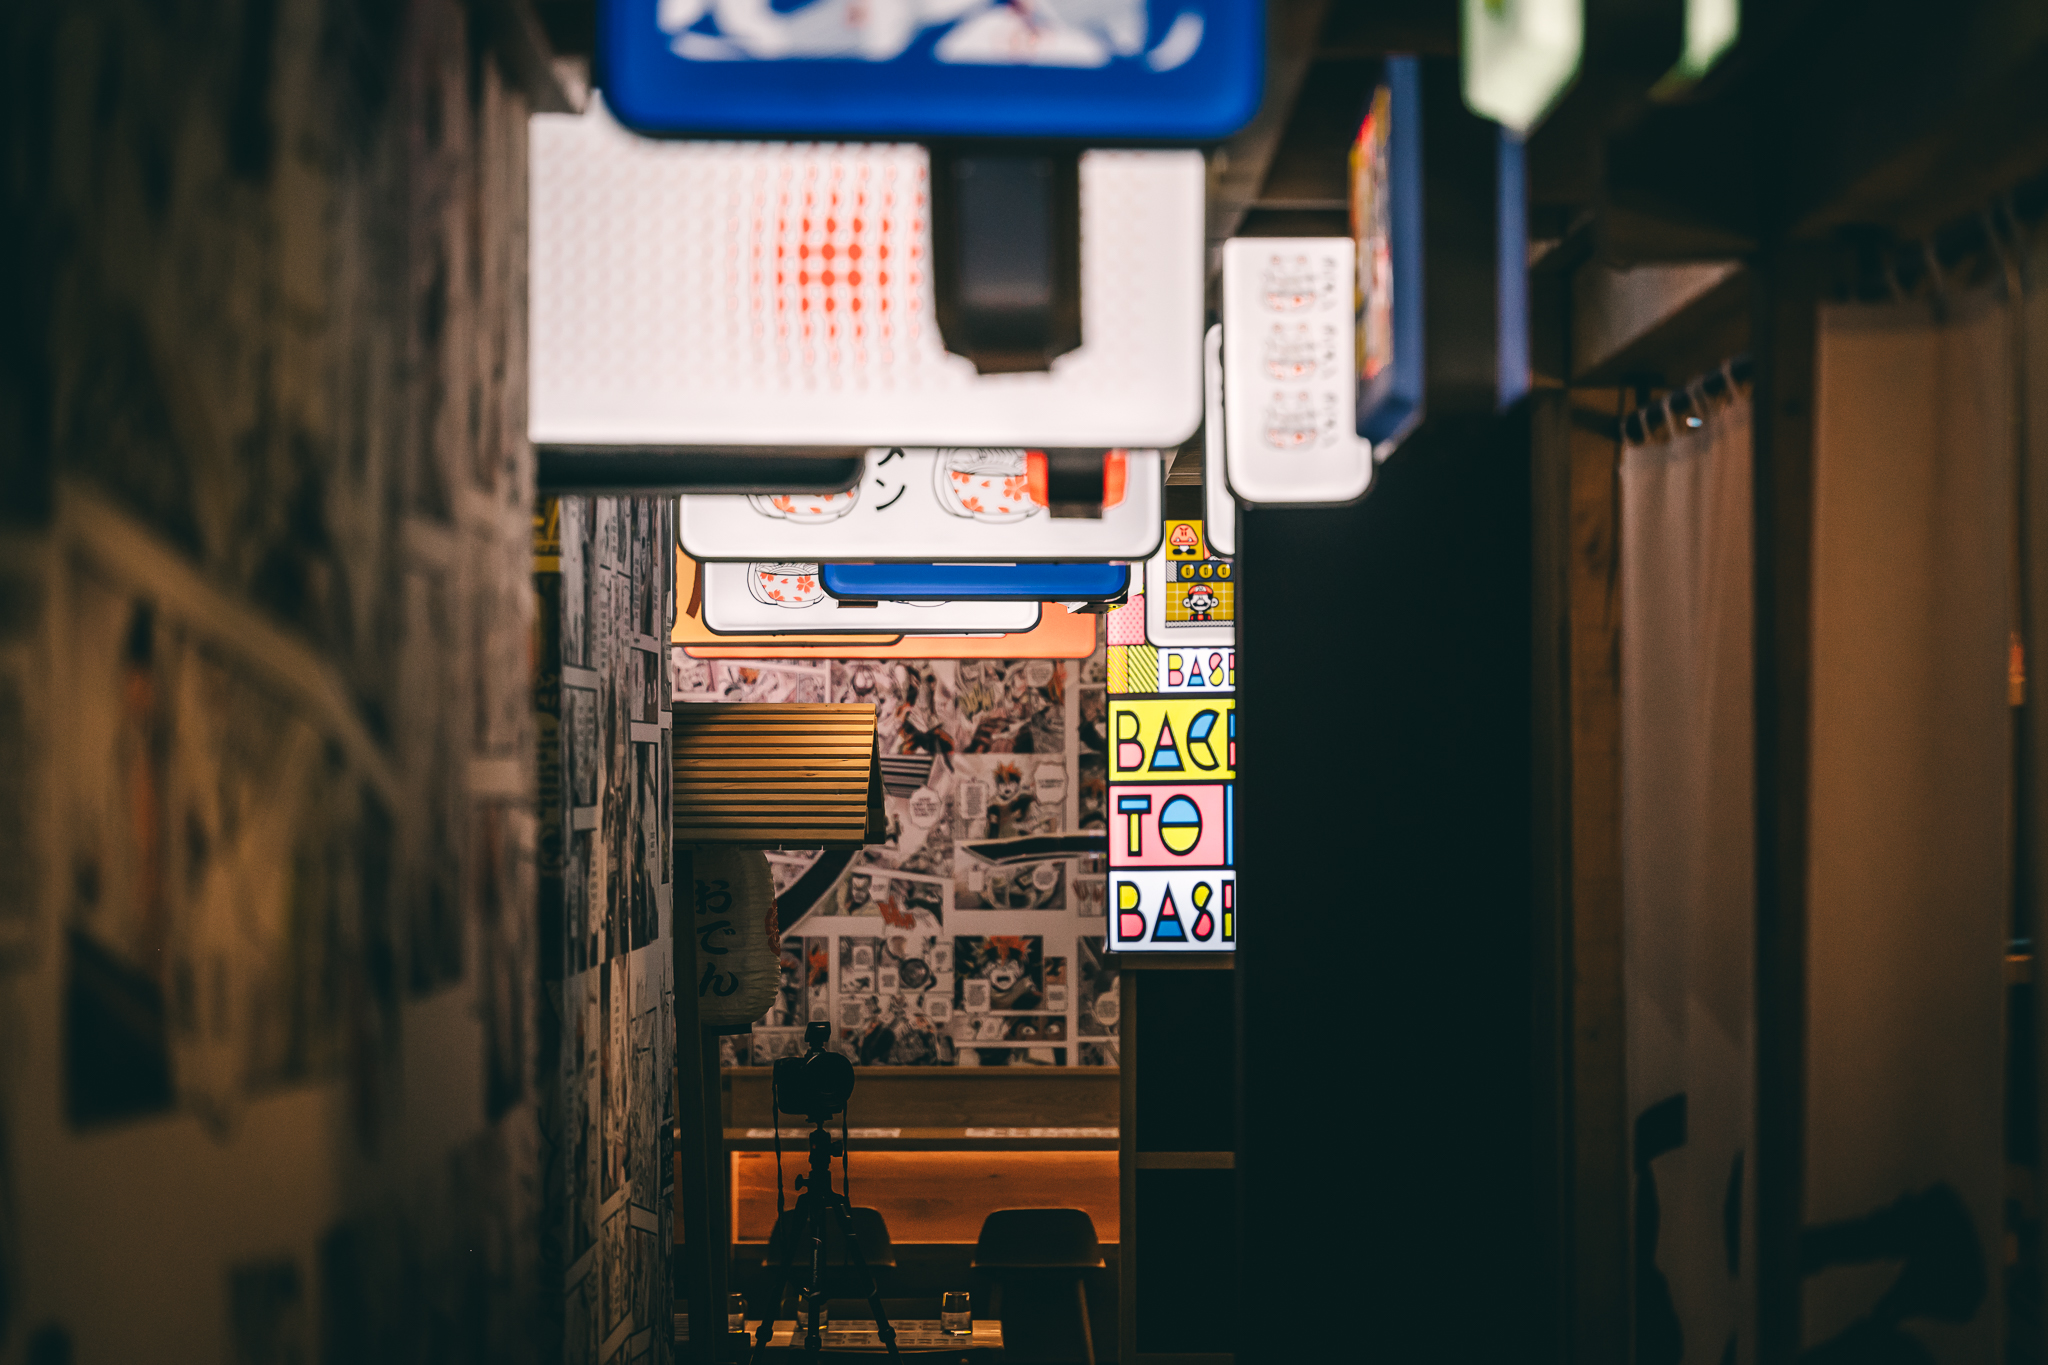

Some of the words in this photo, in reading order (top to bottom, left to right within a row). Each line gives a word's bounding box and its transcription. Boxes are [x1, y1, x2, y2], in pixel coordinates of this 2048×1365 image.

[1116, 709, 1236, 772] BAC
[1117, 793, 1203, 857] TO
[694, 879, 740, 998] おでん
